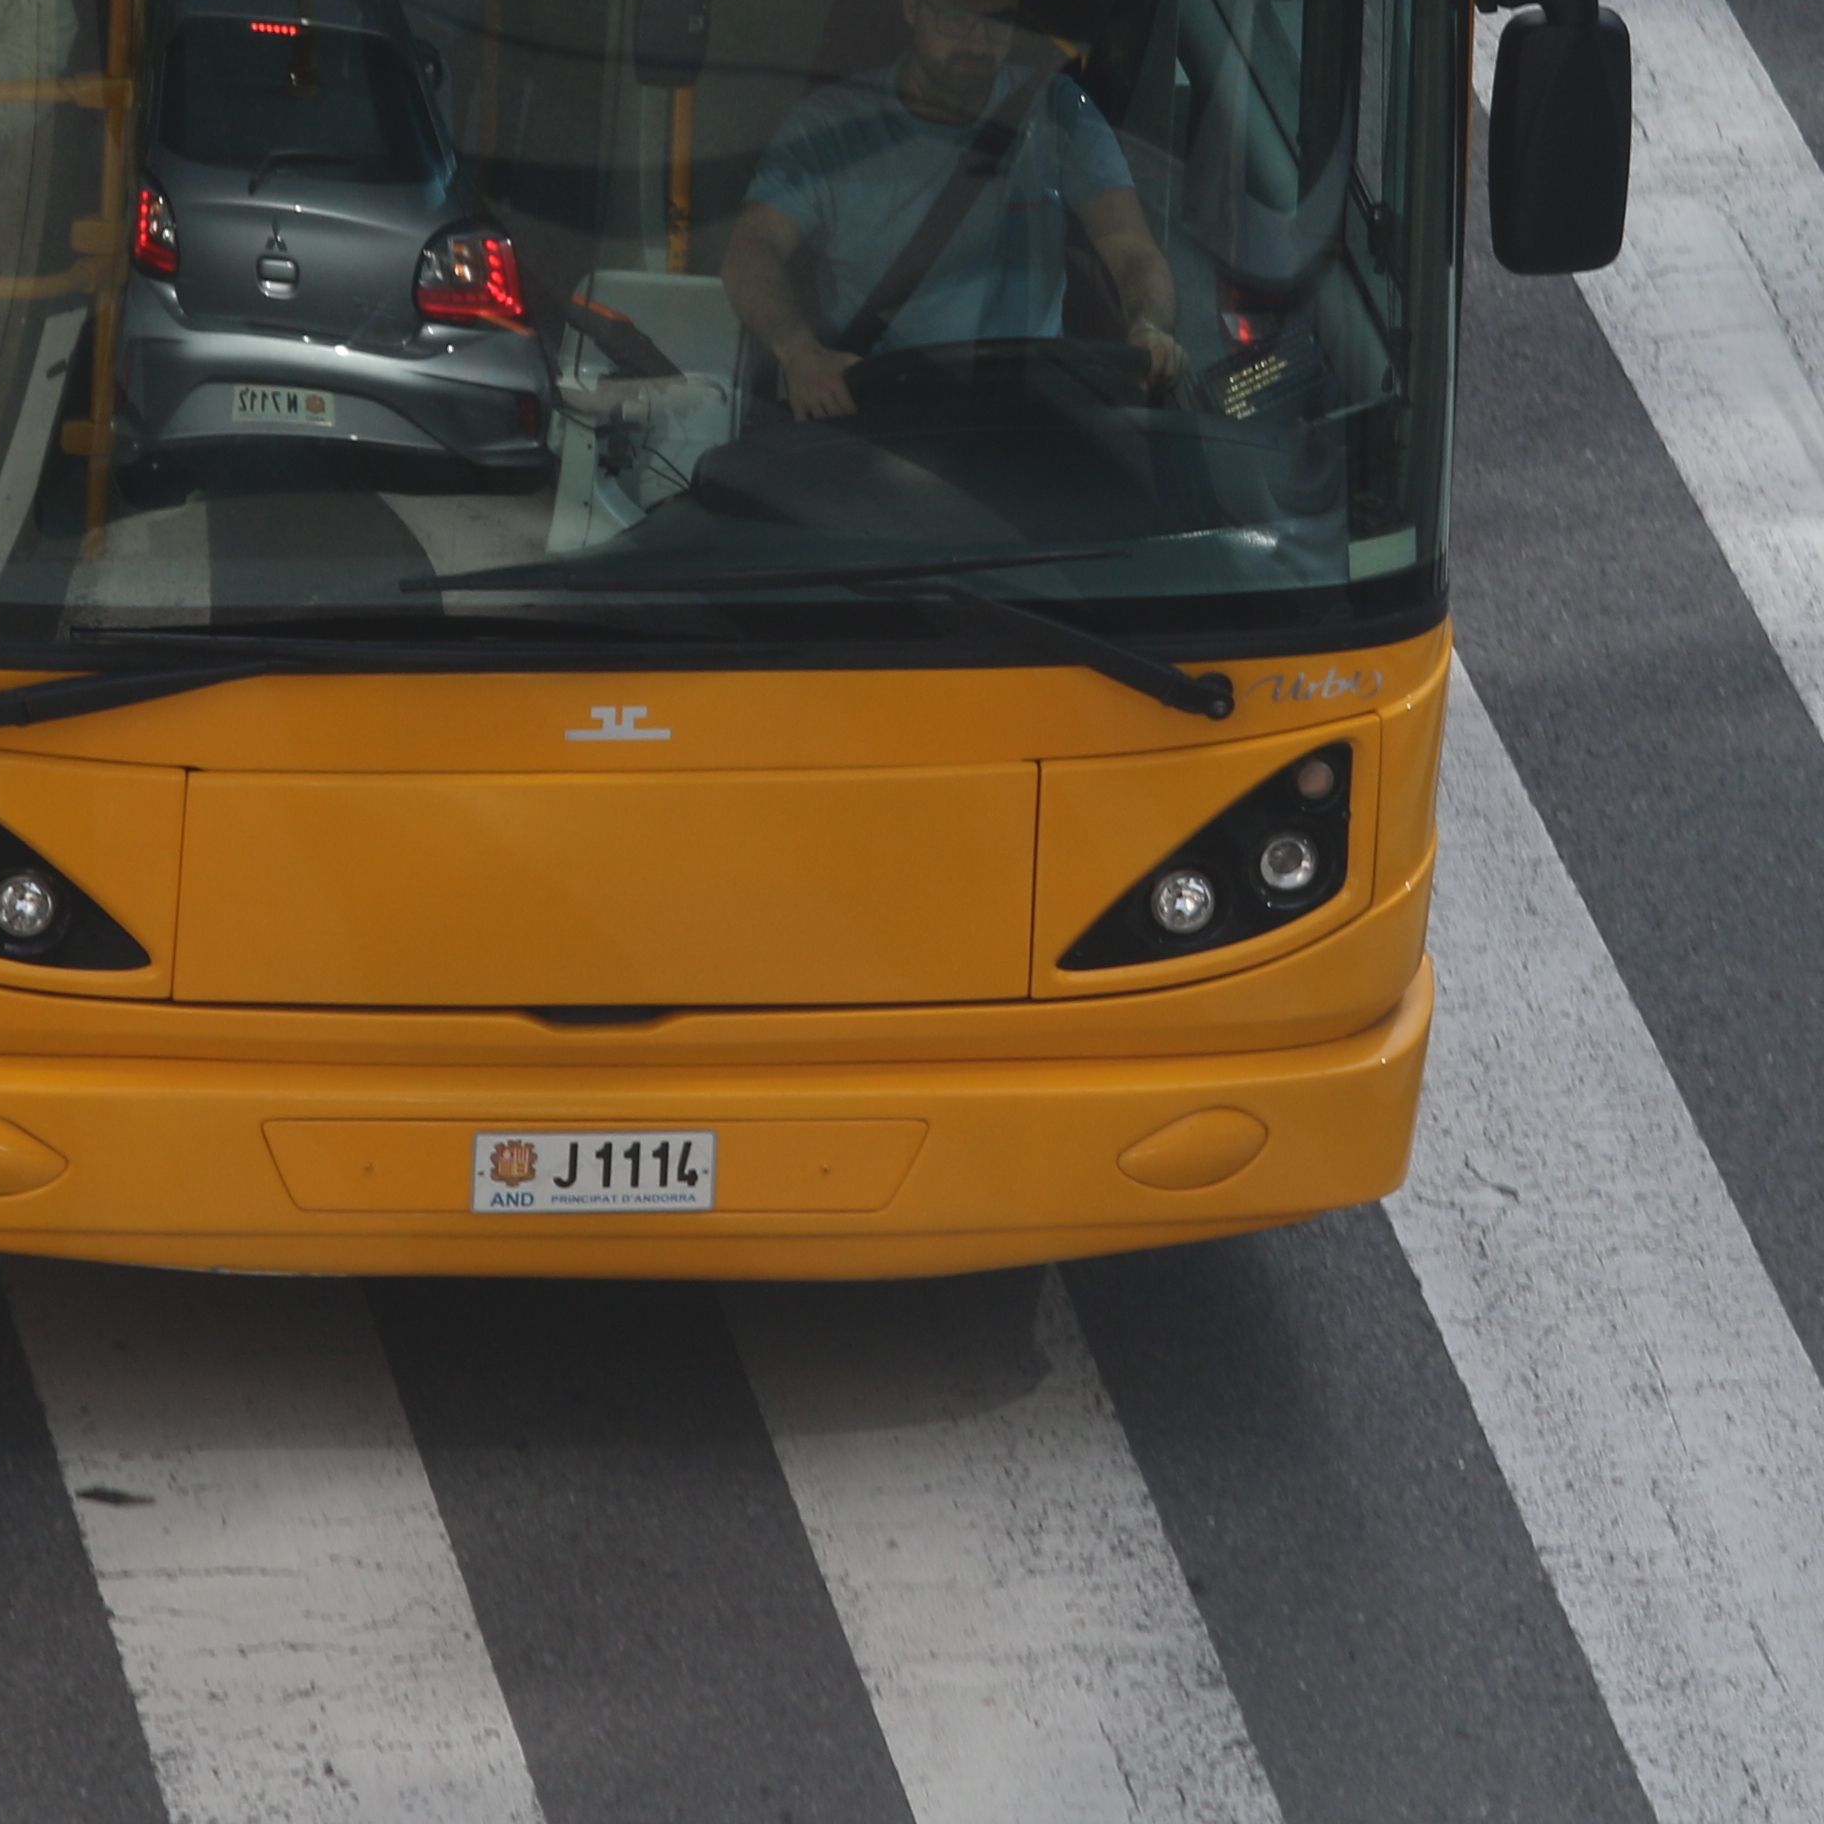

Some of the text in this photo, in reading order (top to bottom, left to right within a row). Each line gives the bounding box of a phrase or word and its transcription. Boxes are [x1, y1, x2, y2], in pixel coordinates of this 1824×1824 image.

[489, 1191, 535, 1208] AND
[550, 1192, 697, 1205] PRINCIPAT D'ANDORRA
